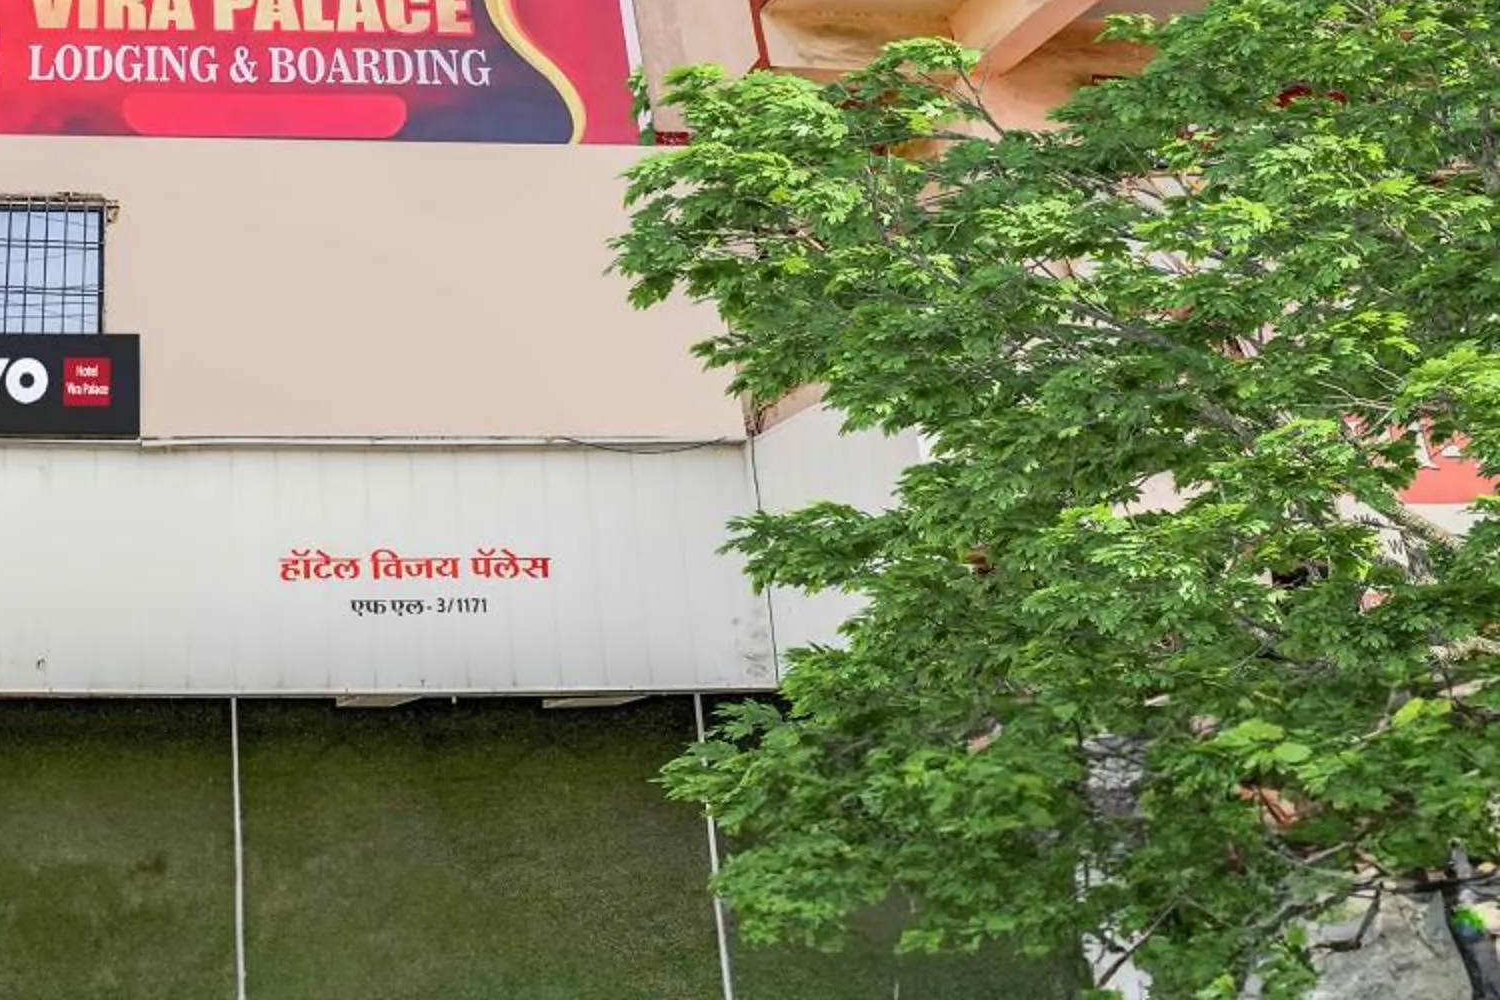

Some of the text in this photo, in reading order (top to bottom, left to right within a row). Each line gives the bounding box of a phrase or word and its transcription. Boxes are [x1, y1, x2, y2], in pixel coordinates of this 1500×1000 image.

[28, 43, 492, 87] LODGING & BOARDING
[279, 549, 551, 581] हॉटेल विजय पॅलेस
